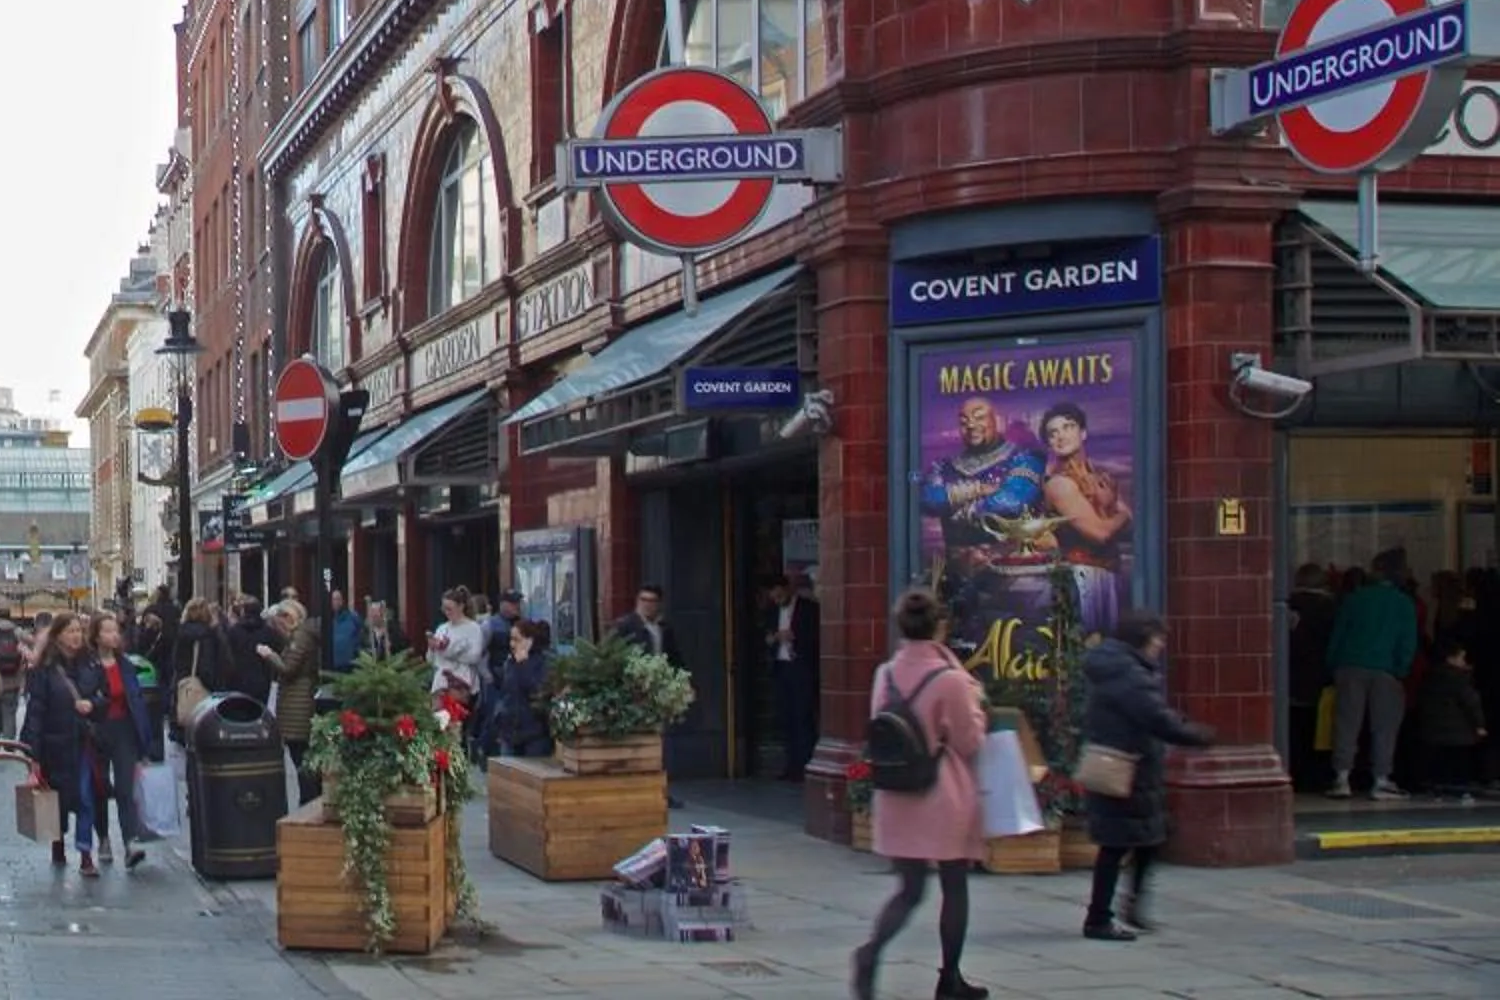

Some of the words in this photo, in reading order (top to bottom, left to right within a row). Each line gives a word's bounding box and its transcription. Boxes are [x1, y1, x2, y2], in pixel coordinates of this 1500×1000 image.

[1253, 14, 1463, 106] UNDERGROUND
[580, 142, 797, 174] UNDERGROUND
[910, 273, 1016, 302] COVENT
[1024, 258, 1138, 291] GARDEN
[425, 319, 481, 379] GARDEN
[518, 267, 595, 337] STATION
[694, 381, 740, 393] COVENT
[743, 381, 791, 393] GARDEN
[940, 360, 1018, 394] MAGIC
[1024, 353, 1113, 389] AWAITS
